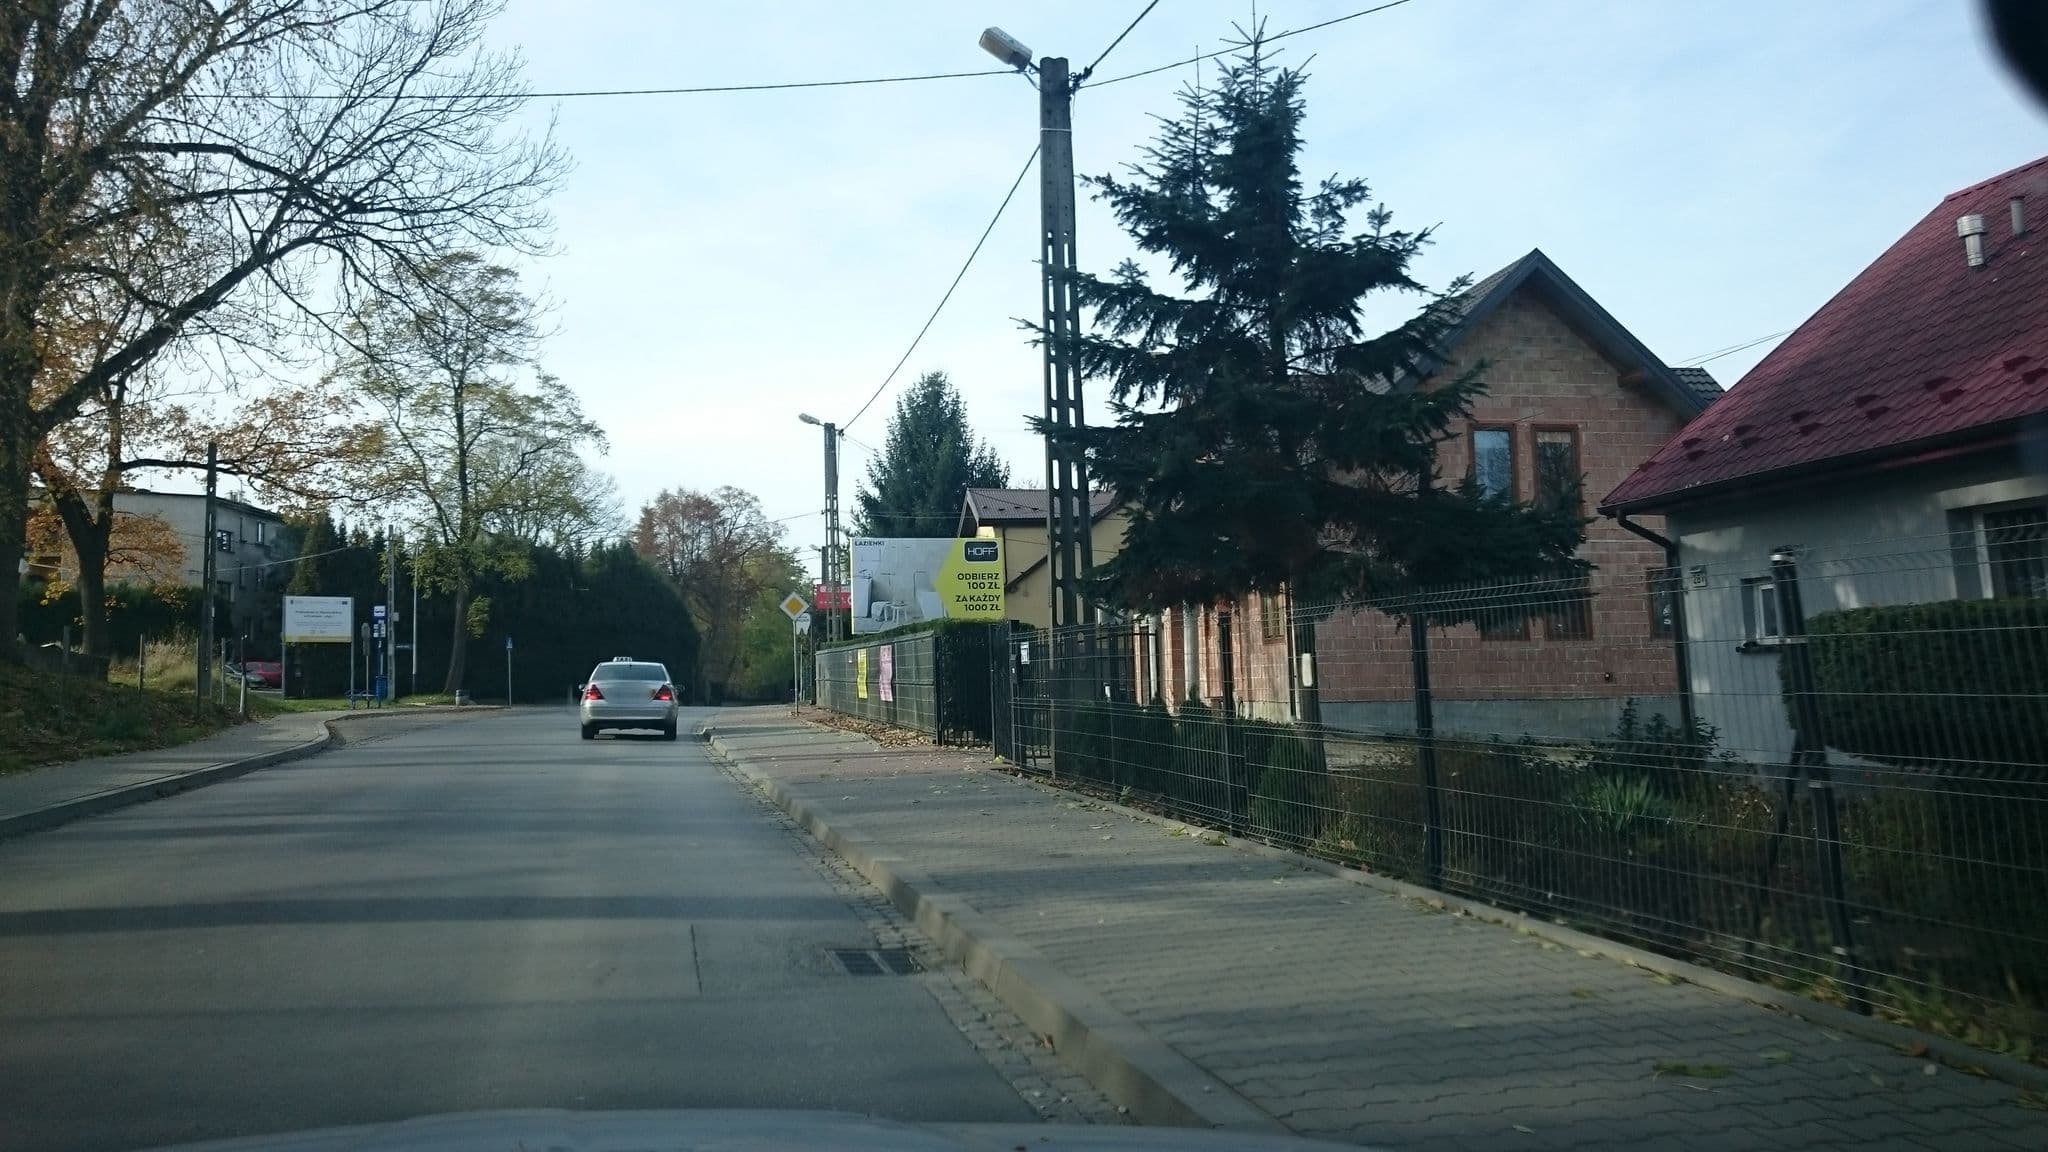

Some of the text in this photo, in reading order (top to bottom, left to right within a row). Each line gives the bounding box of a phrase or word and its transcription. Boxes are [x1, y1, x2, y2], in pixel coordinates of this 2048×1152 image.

[967, 546, 996, 556] HOFF
[969, 593, 1001, 602] KAŻDY
[989, 603, 1001, 611] ZŁ
